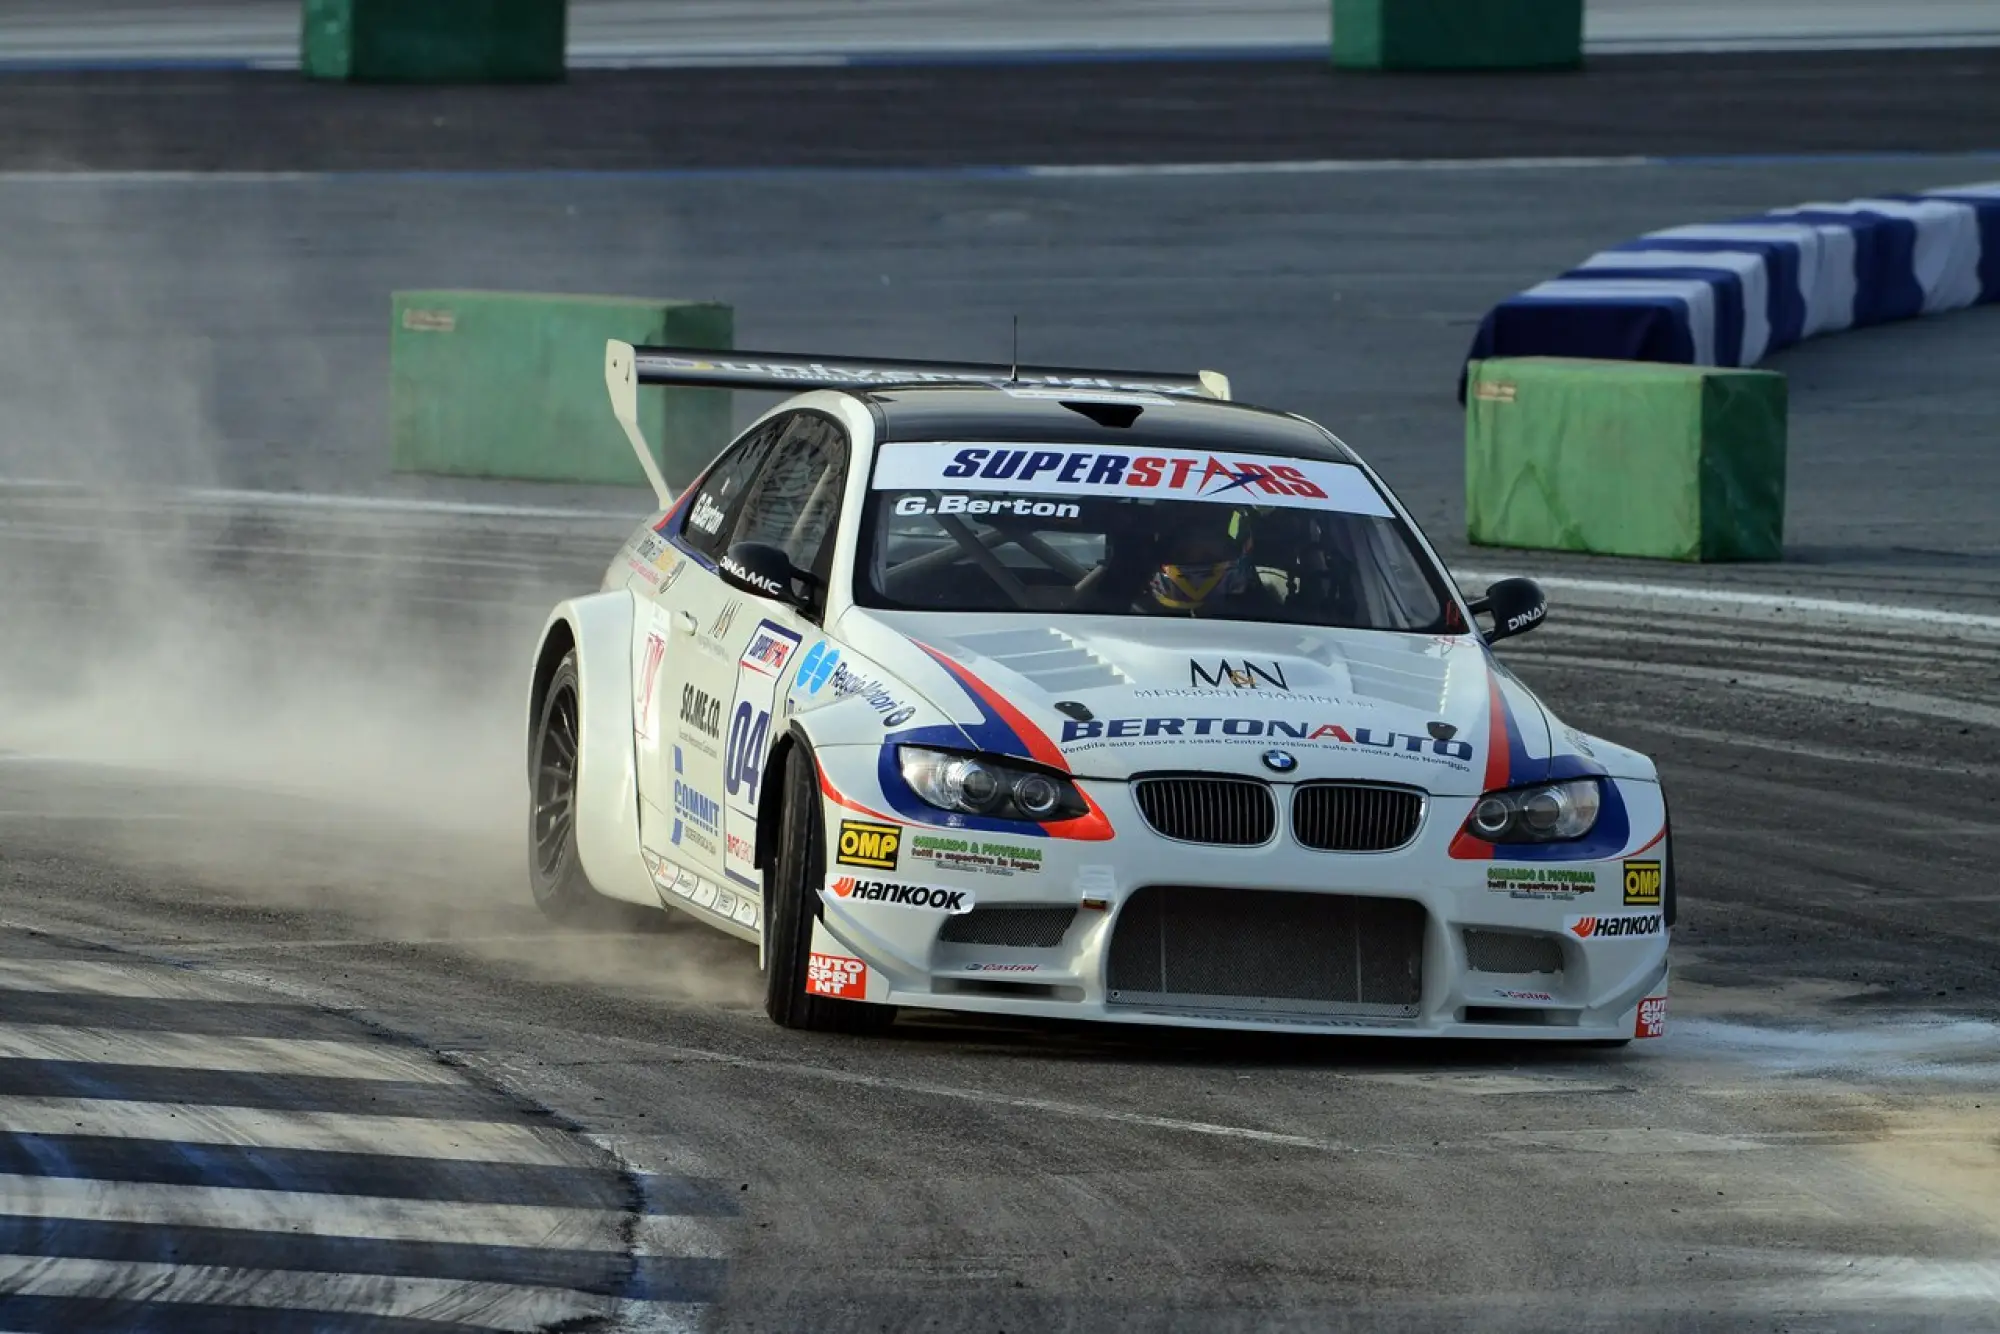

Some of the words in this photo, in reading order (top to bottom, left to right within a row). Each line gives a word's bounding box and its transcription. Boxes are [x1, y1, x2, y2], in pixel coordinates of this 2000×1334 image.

[942, 448, 1328, 500] SUPERSTARS
[895, 495, 1080, 518] G.Berton
[1061, 718, 1473, 762] BERTONAUTO
[1061, 741, 1106, 755] Vendita
[1109, 740, 1136, 748] auto
[726, 701, 771, 805] 04
[840, 829, 899, 860] OMP
[1625, 869, 1660, 896] OMP
[808, 955, 865, 973] AUTO
[808, 966, 857, 985] SPRI
[815, 980, 845, 994] NT
